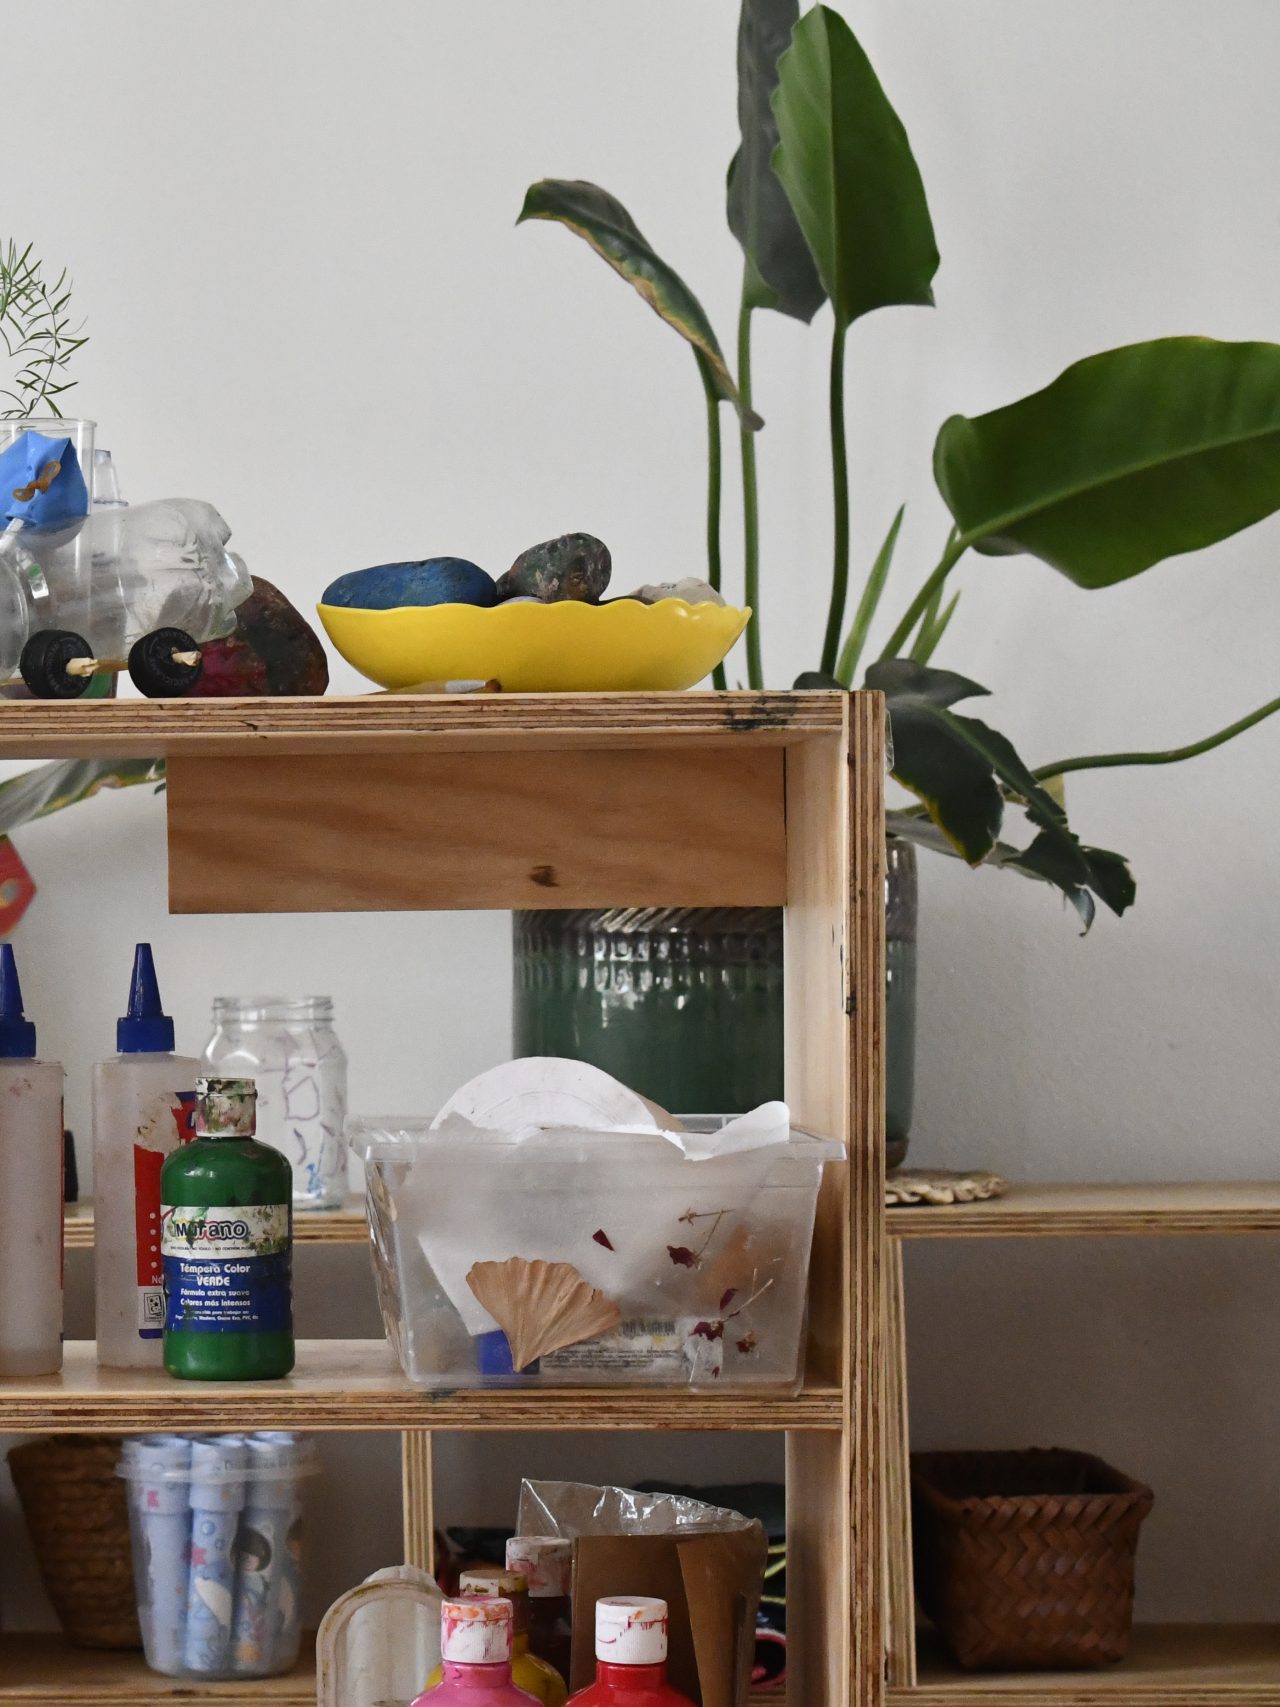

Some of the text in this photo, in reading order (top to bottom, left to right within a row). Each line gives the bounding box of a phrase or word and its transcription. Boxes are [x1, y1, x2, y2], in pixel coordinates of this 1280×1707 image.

[175, 1219, 248, 1239] Murano
[180, 1263, 251, 1275] Témpera Color
[196, 1276, 230, 1286] VERDE
[180, 1288, 205, 1296] Fórmula
[204, 1298, 219, 1306] más
